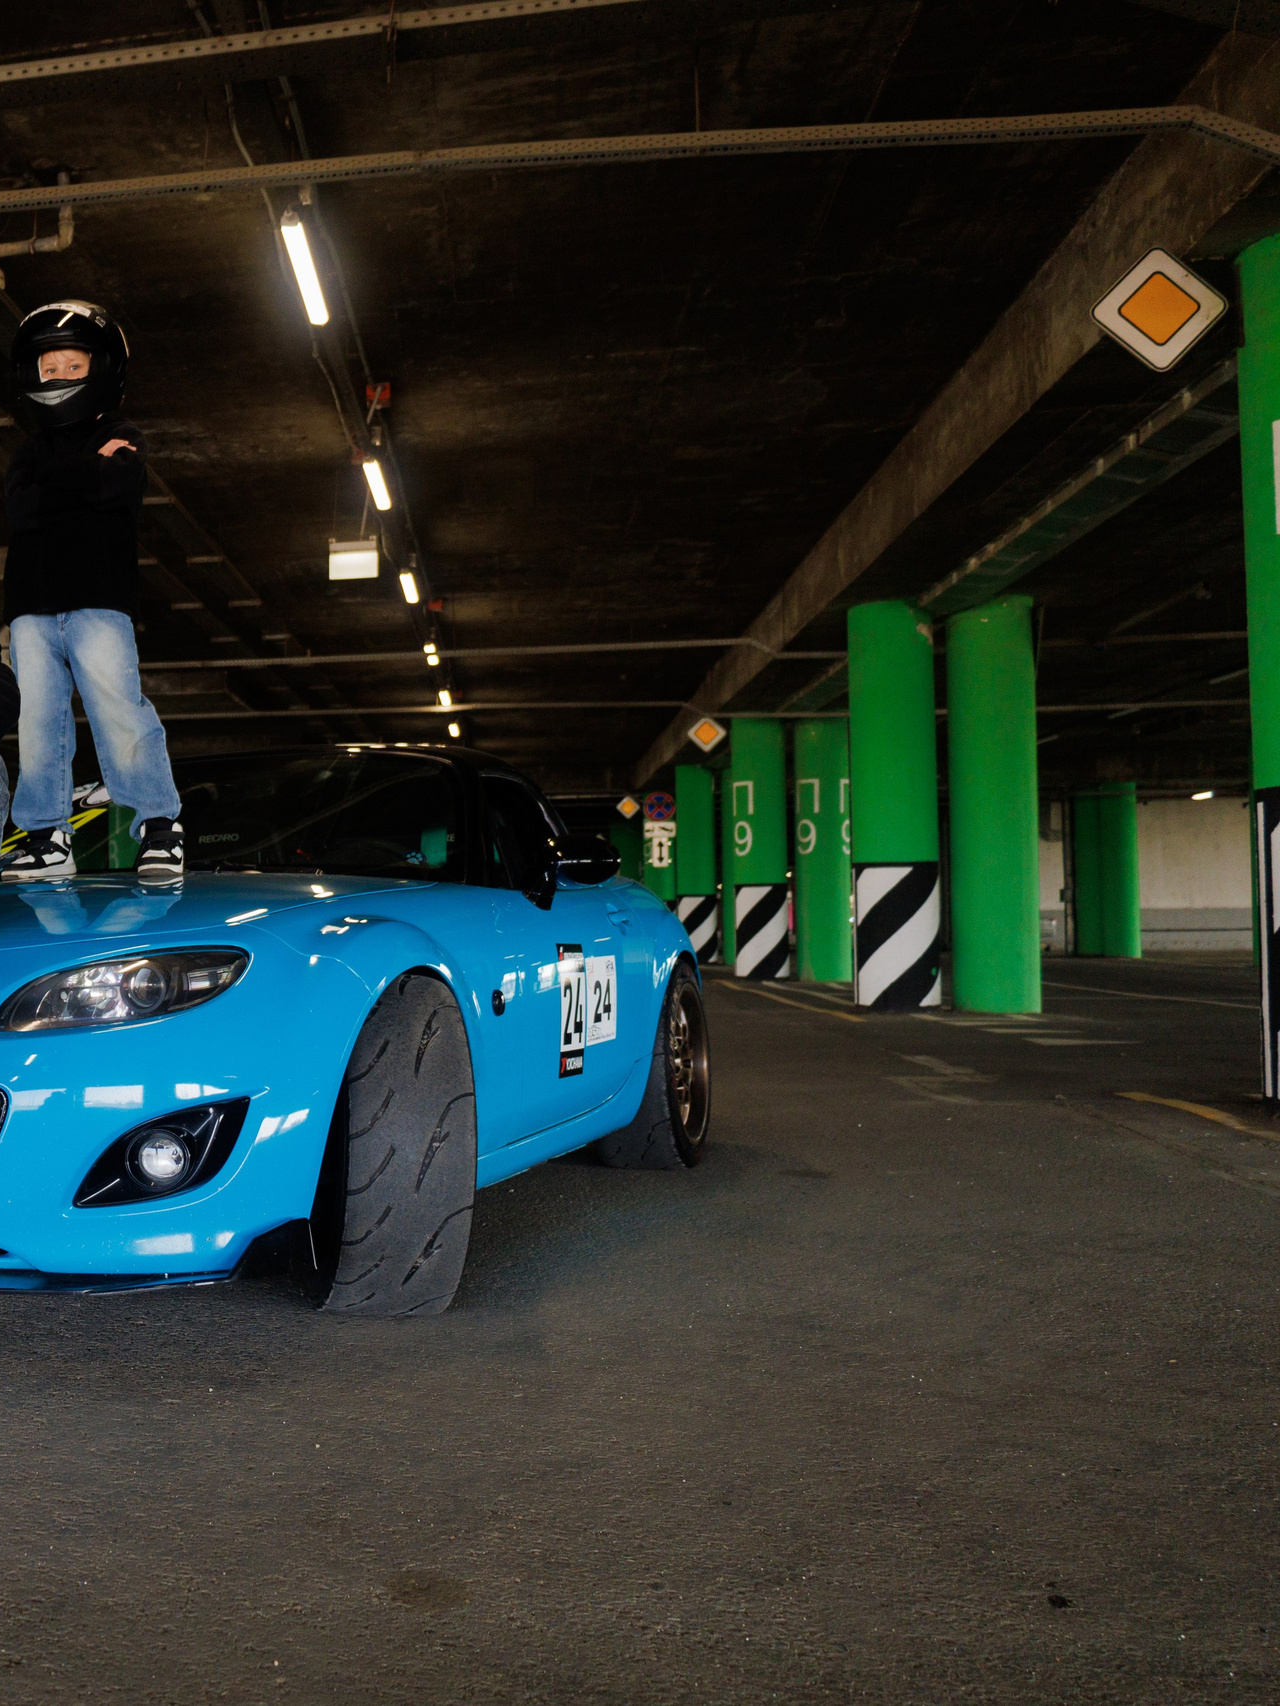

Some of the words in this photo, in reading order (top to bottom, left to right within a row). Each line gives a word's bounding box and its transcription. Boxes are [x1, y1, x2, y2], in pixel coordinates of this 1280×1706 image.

[732, 780, 753, 816] П
[795, 778, 820, 814] П
[198, 833, 240, 844] RECARO
[734, 820, 753, 857] 9
[797, 818, 817, 855] 9
[563, 977, 583, 1046] 24
[593, 978, 612, 1024] 24
